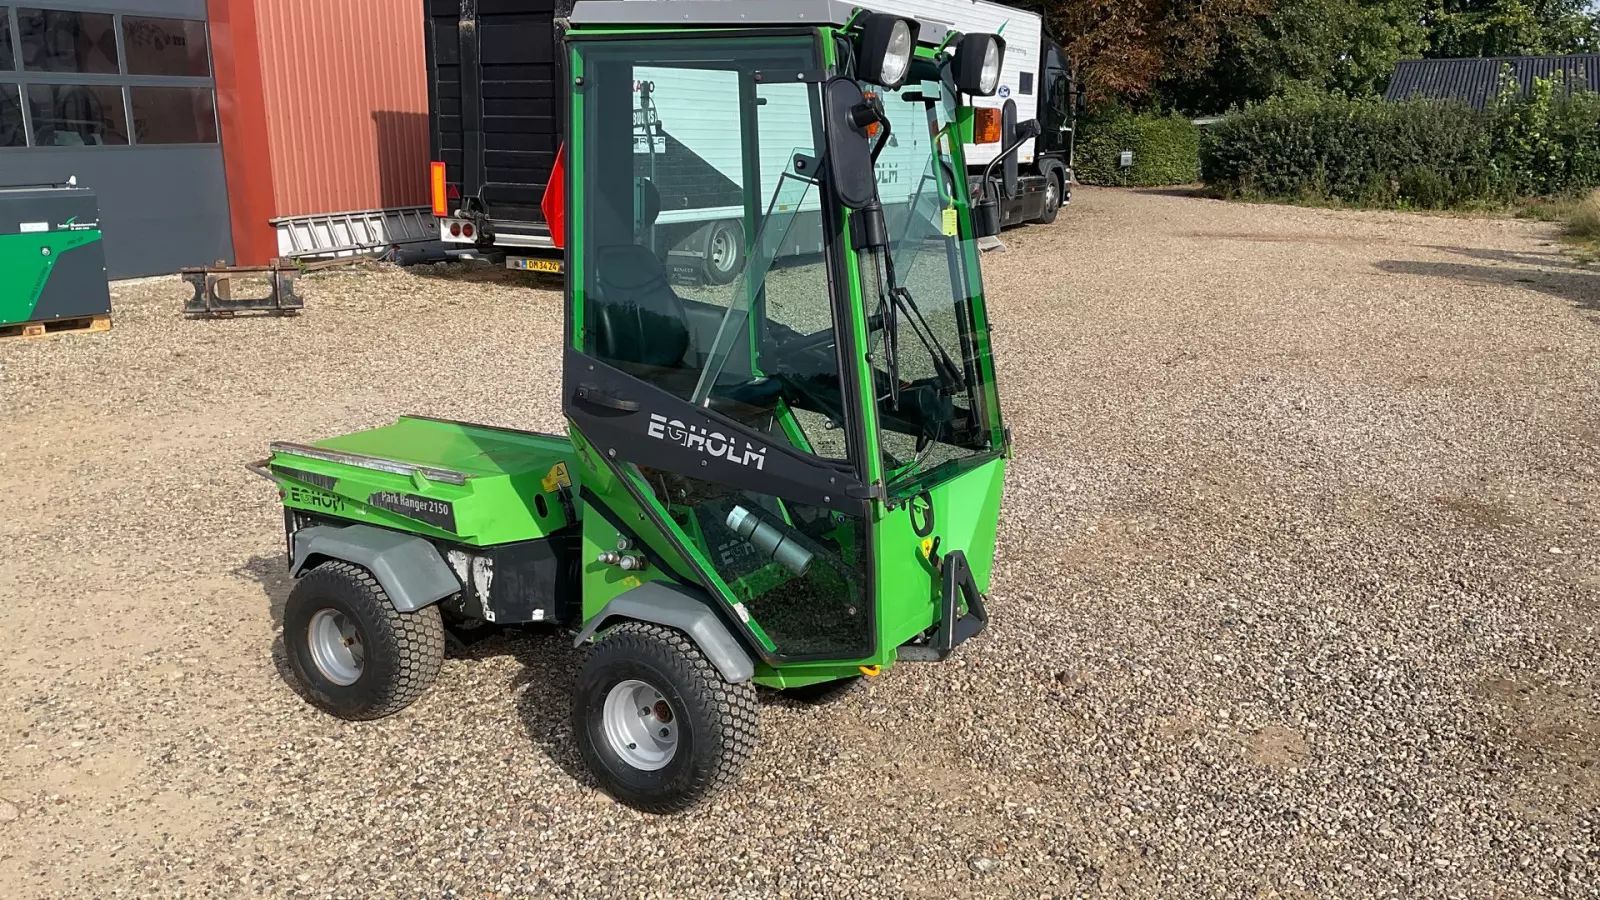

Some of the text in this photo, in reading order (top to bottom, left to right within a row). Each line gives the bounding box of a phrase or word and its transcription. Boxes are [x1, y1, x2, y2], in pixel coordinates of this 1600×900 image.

[647, 413, 767, 471] EGHOLM
[381, 488, 449, 515] Park Ranger 2150
